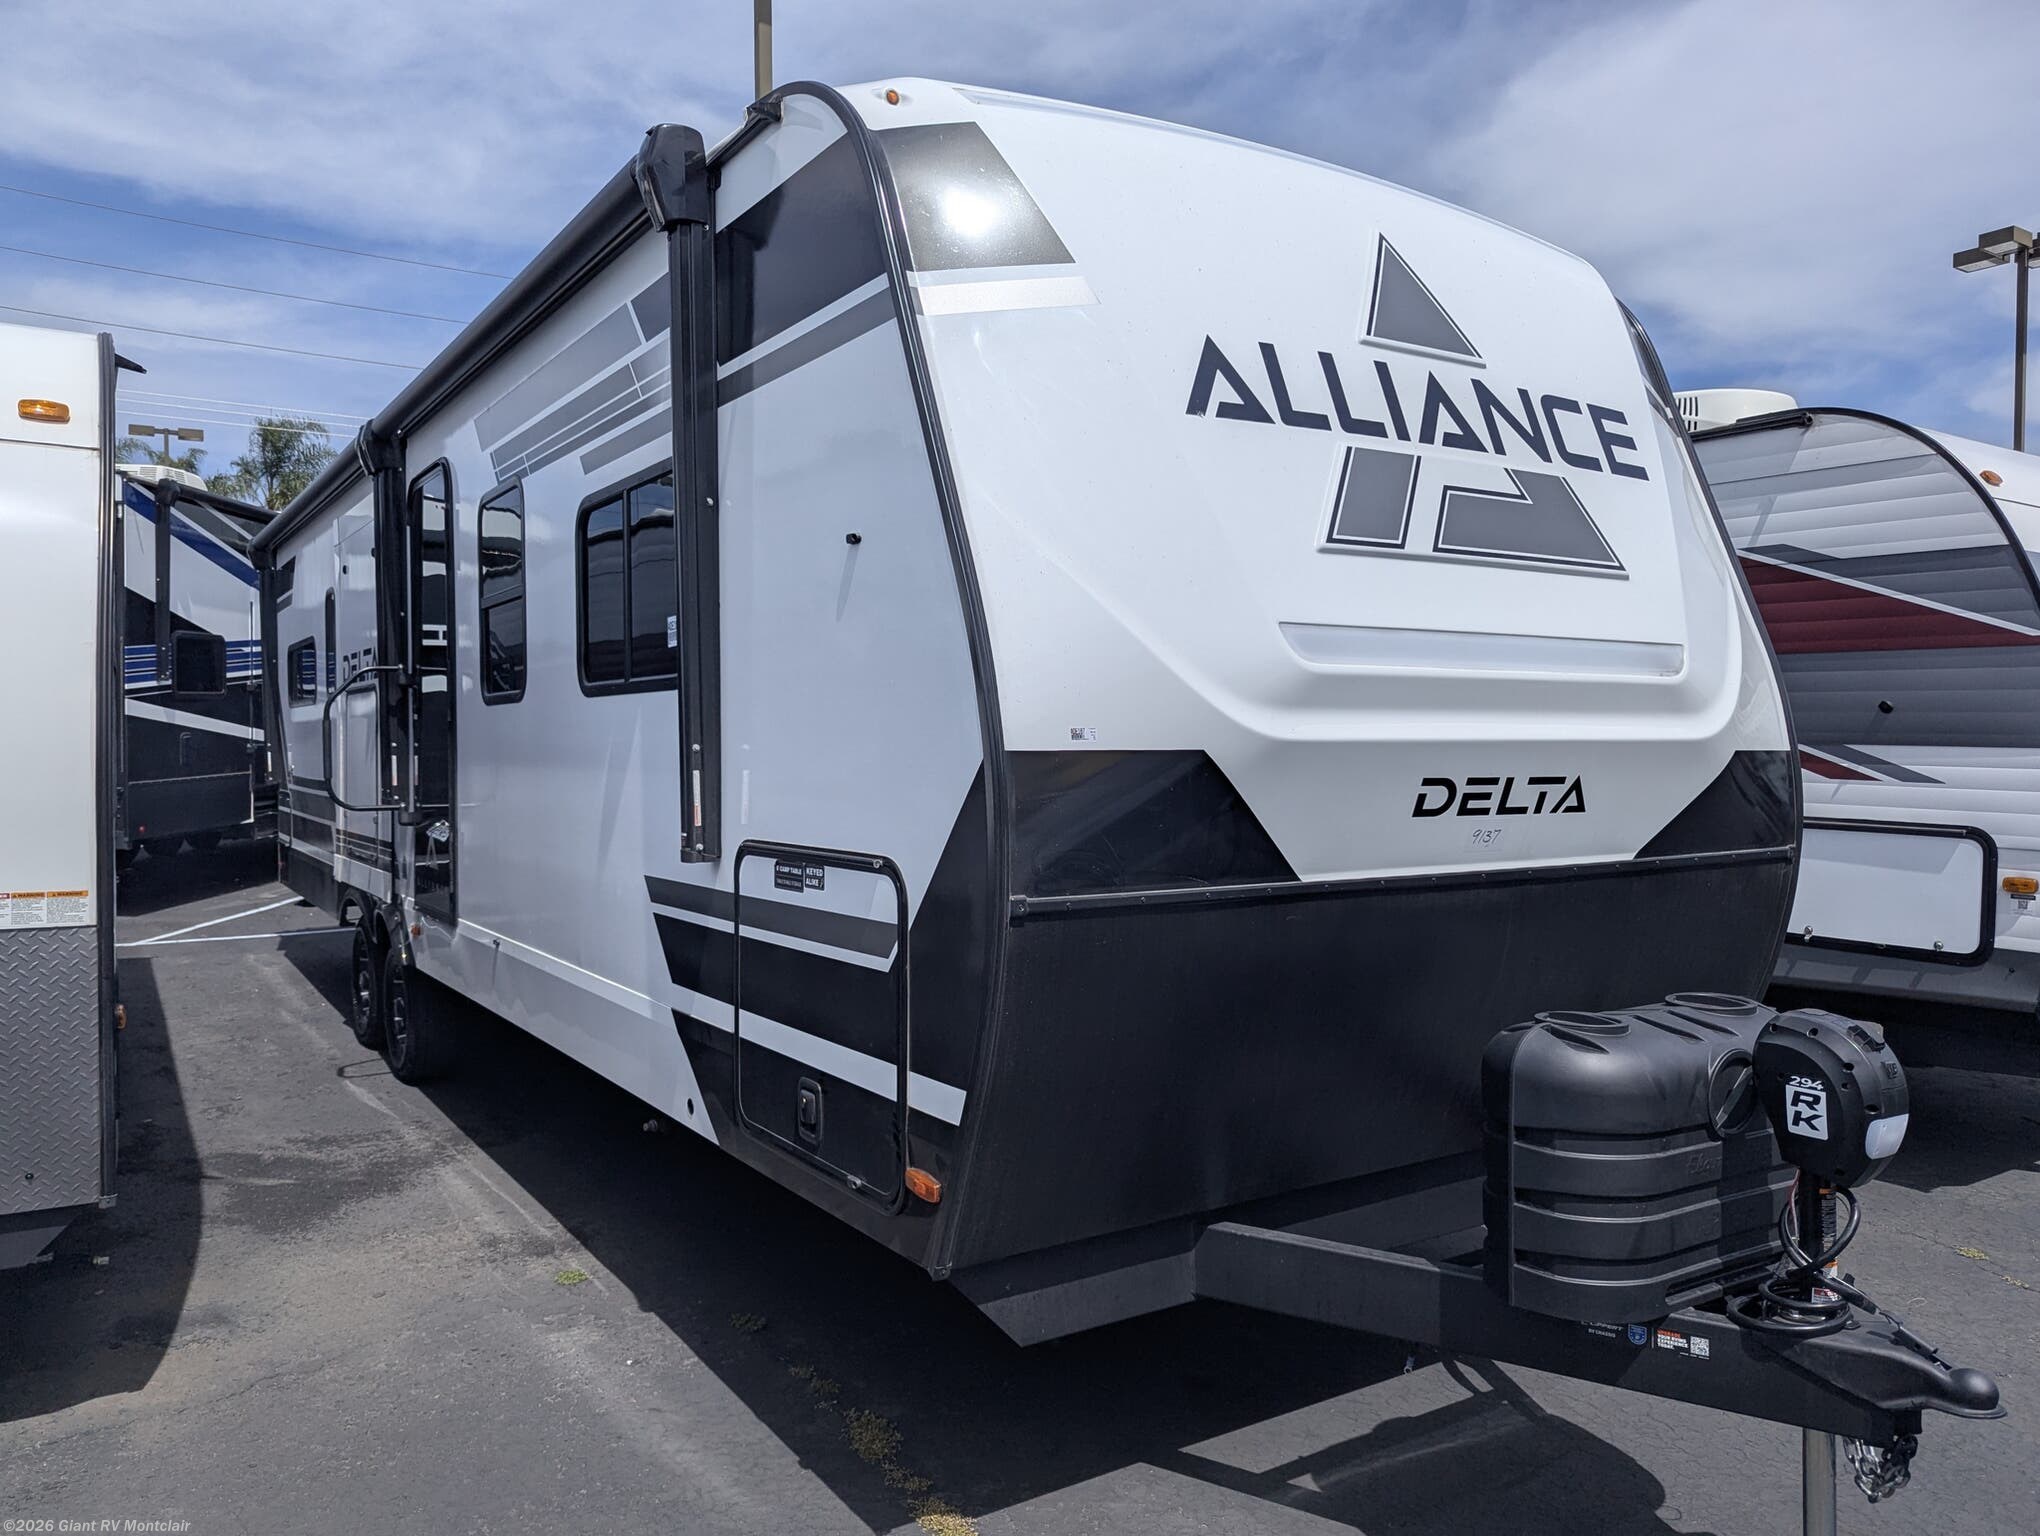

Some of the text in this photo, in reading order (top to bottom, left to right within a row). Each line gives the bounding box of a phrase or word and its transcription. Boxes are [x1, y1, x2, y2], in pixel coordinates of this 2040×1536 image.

[1185, 334, 1650, 481] ALLIANCE
[1411, 774, 1586, 817] DELTA
[1472, 829, 1502, 845] 9137
[806, 868, 823, 877] KEYED
[806, 878, 819, 887] ALIKE
[1789, 1075, 1824, 1091] 294
